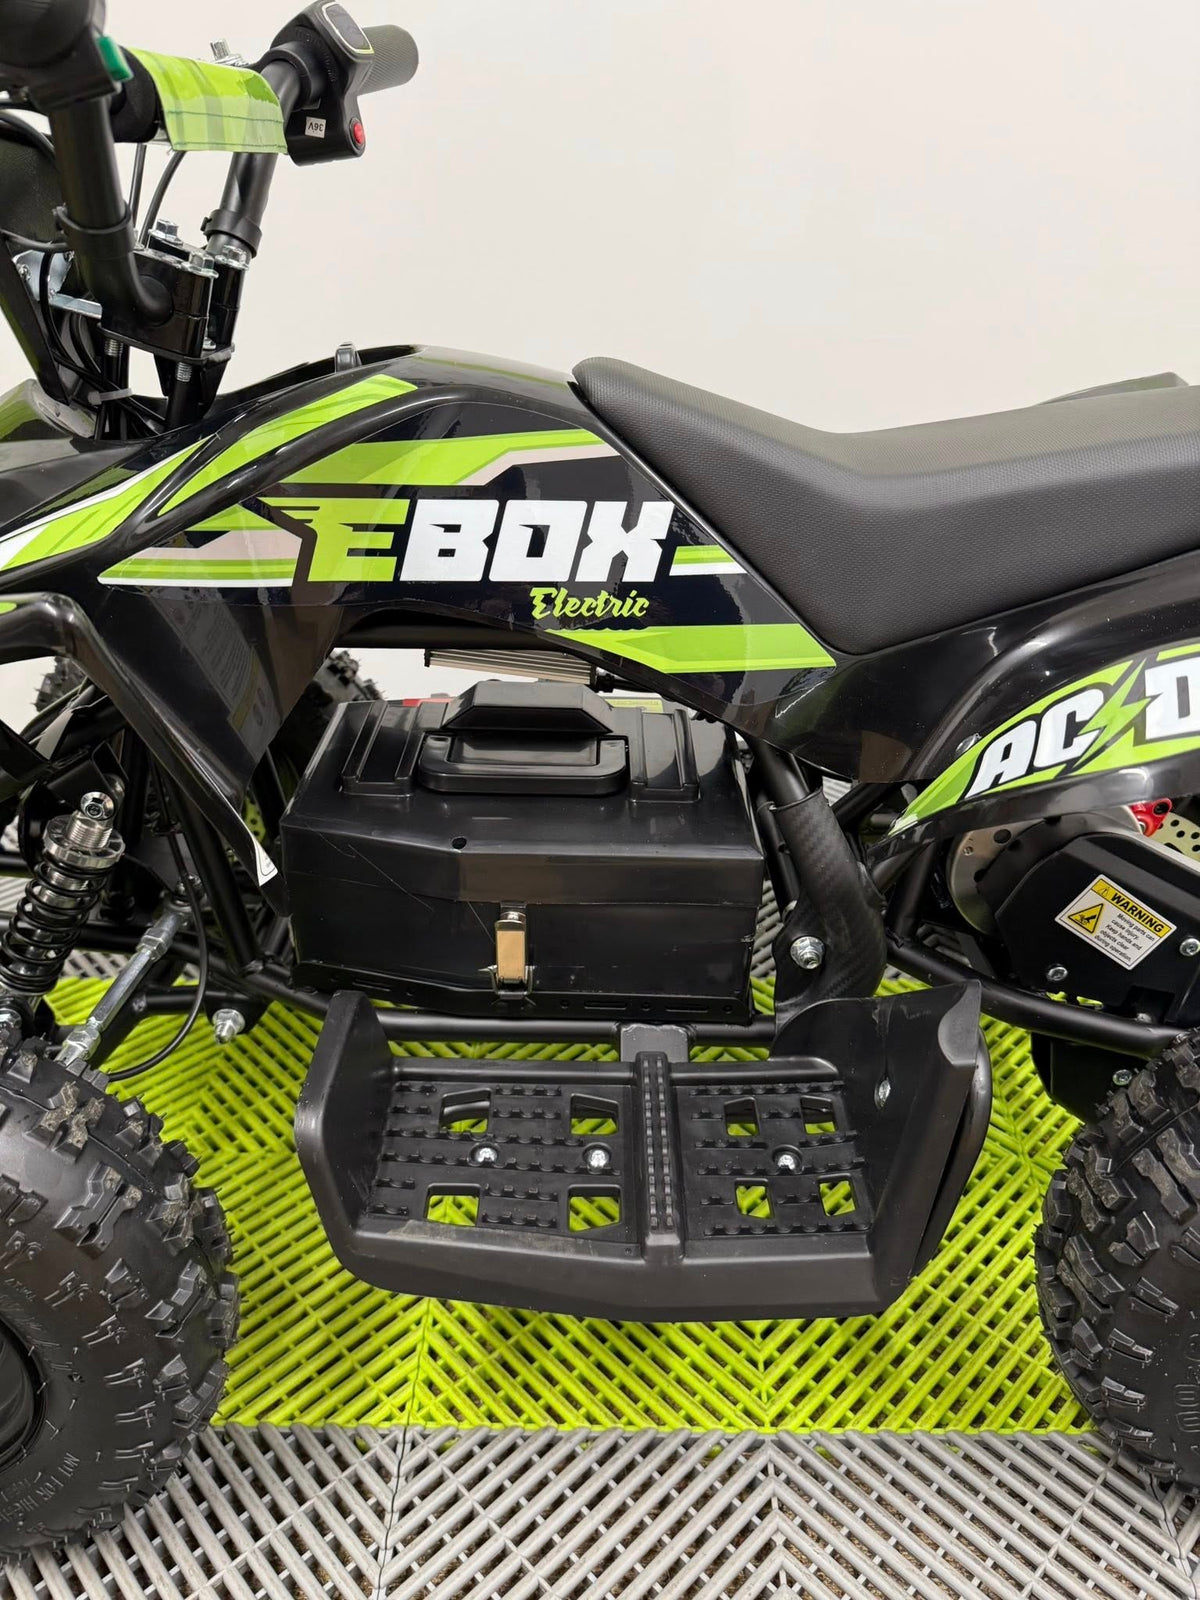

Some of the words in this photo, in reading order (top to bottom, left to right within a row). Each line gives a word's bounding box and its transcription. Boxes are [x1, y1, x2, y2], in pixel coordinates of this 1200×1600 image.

[308, 121, 324, 132] 36V
[257, 497, 675, 582] EBOX
[530, 587, 650, 619] Electric
[964, 688, 1105, 799] AC
[1111, 892, 1165, 933] WARNING
[1111, 919, 1126, 930] cause
[1094, 934, 1111, 947] during
[1100, 929, 1118, 943] objects
[1116, 941, 1130, 950] clear
[1105, 924, 1119, 935] Keep
[1118, 932, 1133, 944] hands
[1131, 942, 1143, 950] and
[1117, 913, 1135, 928] Moving
[1133, 925, 1147, 936] parts
[1145, 933, 1155, 941] can
